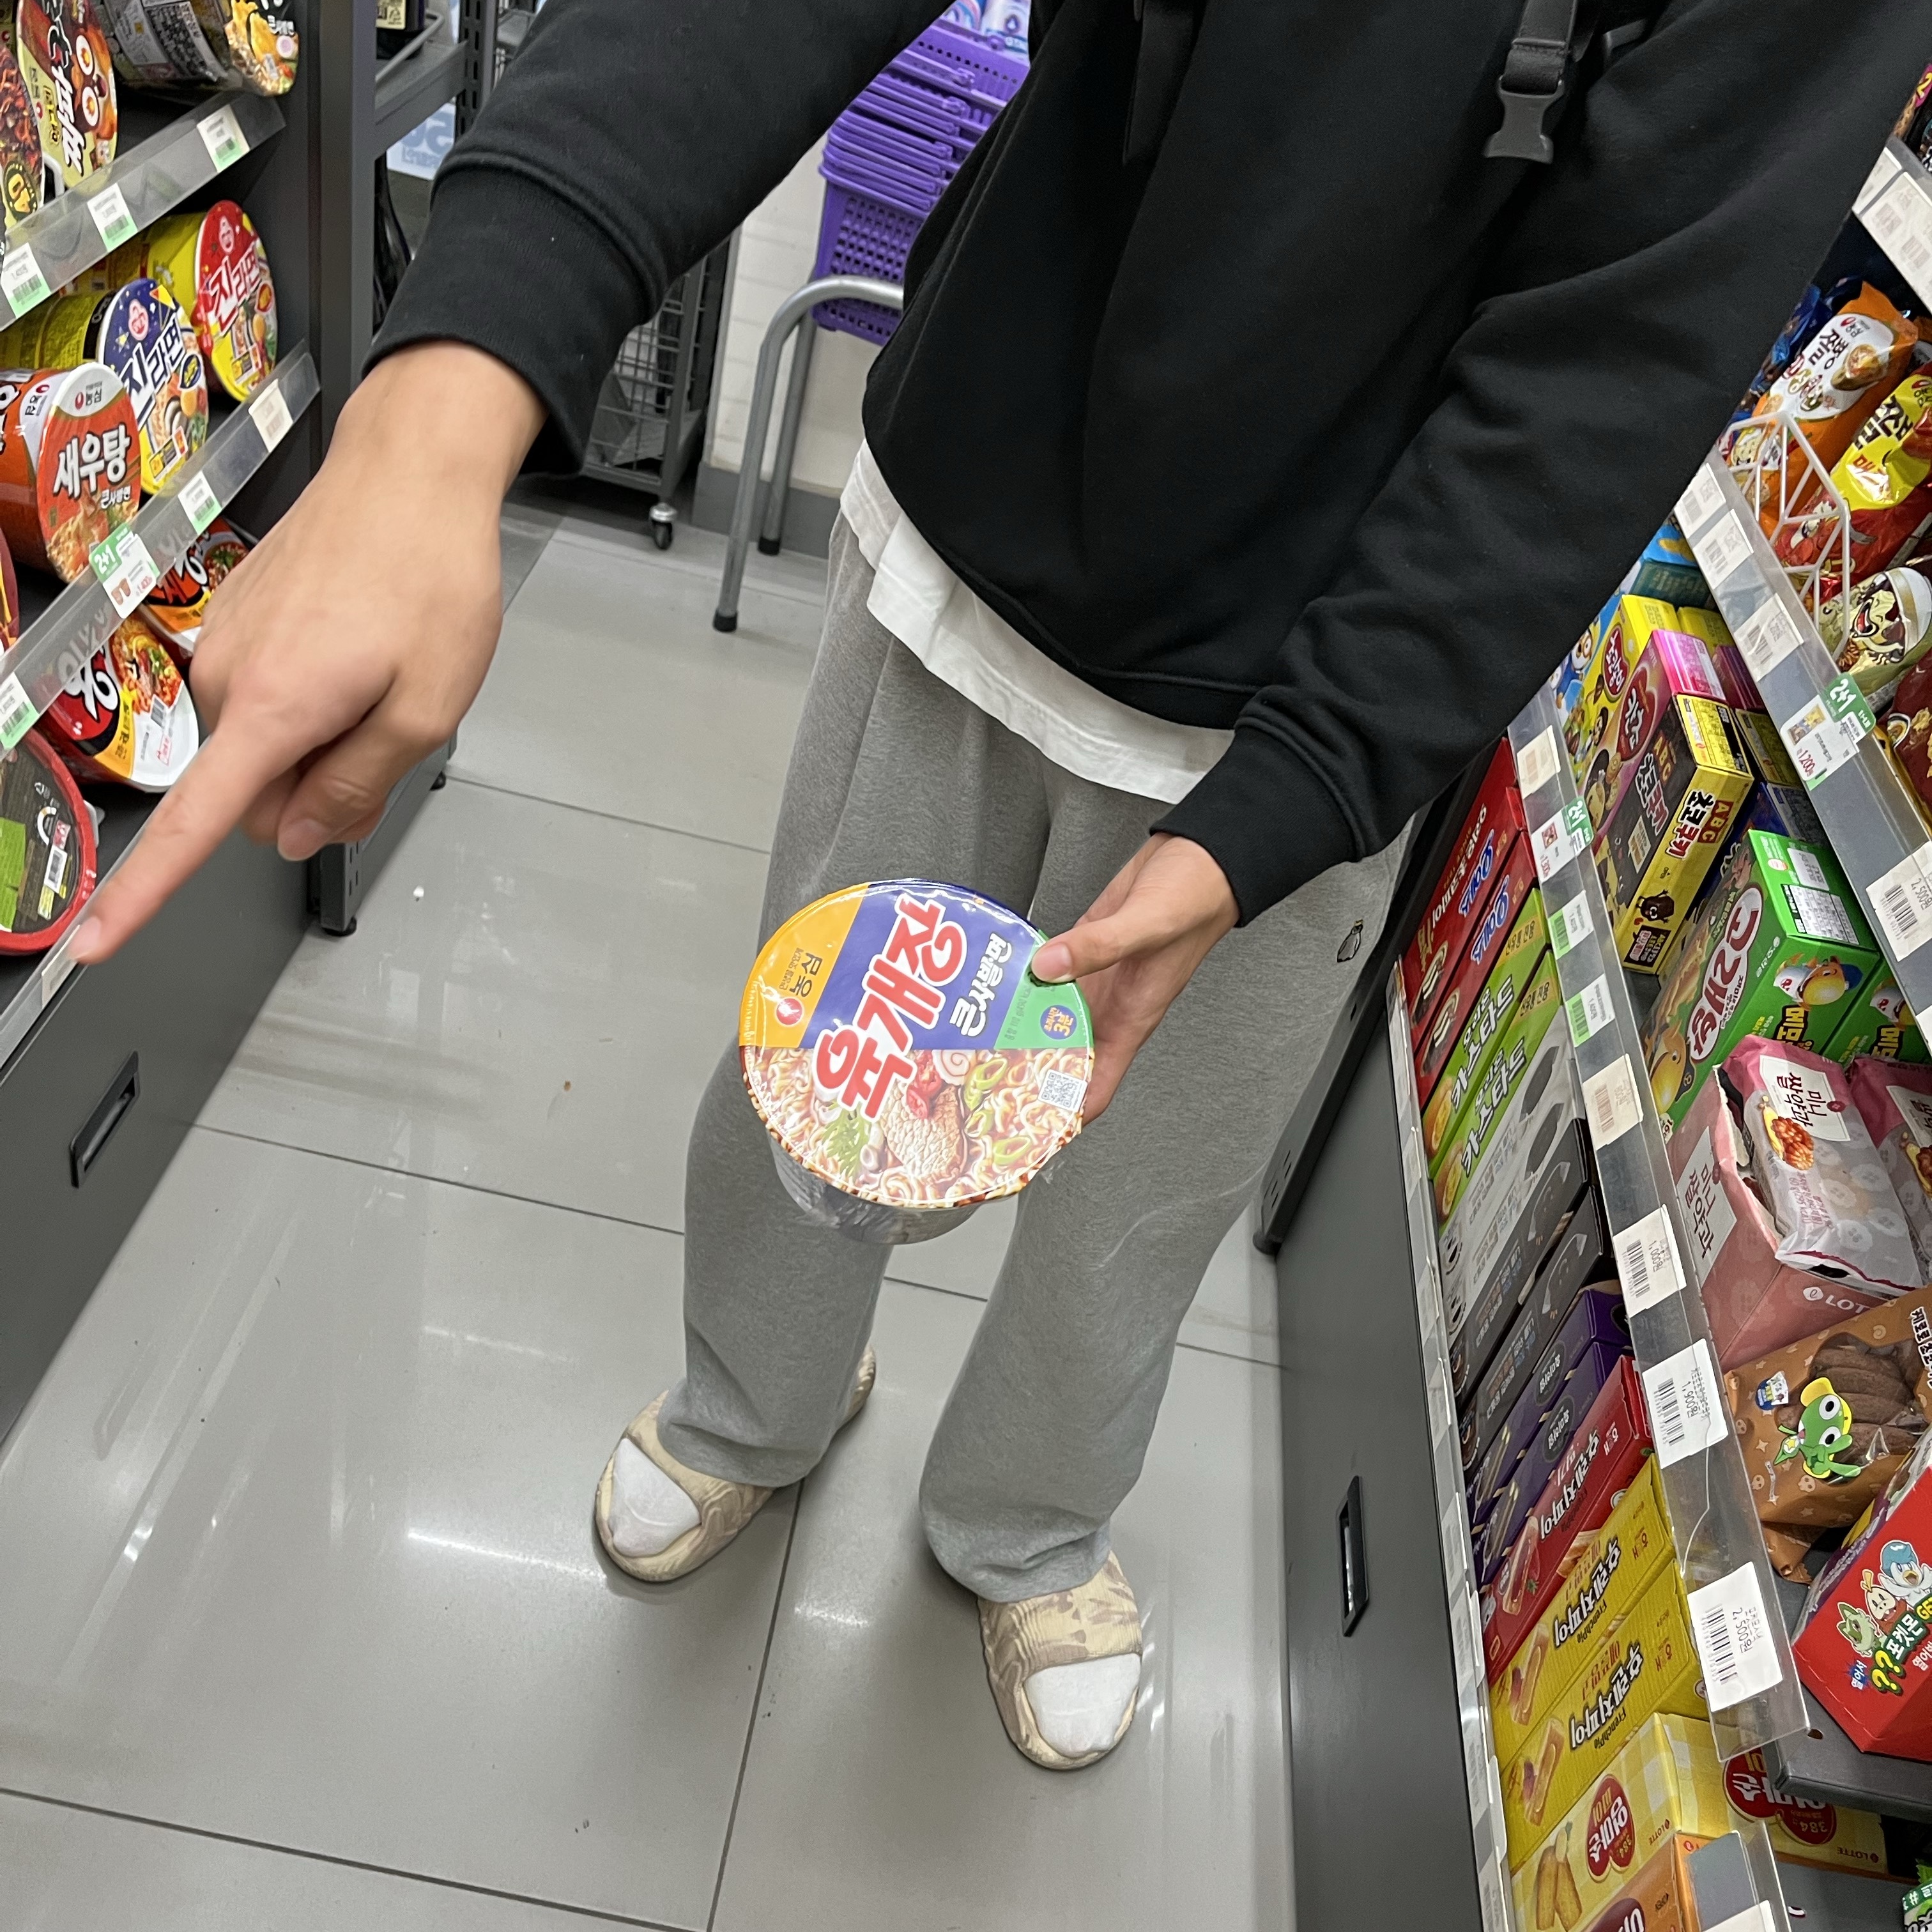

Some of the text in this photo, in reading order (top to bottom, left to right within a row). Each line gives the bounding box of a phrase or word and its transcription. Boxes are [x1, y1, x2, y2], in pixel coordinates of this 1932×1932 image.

[208, 240, 262, 337] 진라면
[1809, 328, 1850, 371] 쫄병
[1845, 321, 1864, 338] 농심
[119, 312, 186, 432] 진라면
[53, 422, 131, 498] 새우탕
[93, 544, 116, 574] 2+1
[1605, 629, 1625, 693] 초코송이
[1829, 678, 1857, 713] 2+1
[1653, 735, 1672, 782] ABC
[1567, 799, 1587, 829] 2+1
[1635, 753, 1669, 836] 초코쿠키
[1701, 801, 1731, 842] ABC
[1462, 803, 1487, 861] 오리온
[1665, 789, 1716, 859] 초코쿠키
[1431, 858, 1466, 928] 초코파이
[1457, 829, 1495, 917] 오예스
[1470, 874, 1510, 965] 오예스
[790, 952, 823, 998] 농심
[949, 933, 1012, 1037] 큰사발면
[1690, 906, 1761, 1057] 고래밥
[814, 895, 966, 1120] 육개장
[1053, 1015, 1074, 1037] 3분
[1450, 974, 1515, 1113] 카스타드
[1462, 1038, 1527, 1177] 카스타드
[1776, 1072, 1814, 1126] 쌀약과
[1807, 1091, 1828, 1118] 미니
[1685, 1169, 1715, 1259] 쌀약과
[1701, 1163, 1716, 1216] 미니
[1646, 1239, 1662, 1275] 1,000원
[1682, 1381, 1699, 1420] 1,900원
[1540, 1429, 1600, 1541] 후렌치파이
[1553, 1537, 1621, 1648] 후렌치파이
[1731, 1606, 1753, 1653] 2,500원
[1885, 1614, 1925, 1660] 포켓몬
[1569, 1641, 1644, 1752] 후렌치파이
[1850, 1659, 1868, 1690] 열어서
[1594, 1707, 1627, 1750] FrenchPie
[1588, 1796, 1628, 1864] 엄마손
[1591, 1786, 1613, 1828] 파이
[1648, 1825, 1666, 1846] LOTTE
[1837, 1846, 1870, 1863] LOTTE
